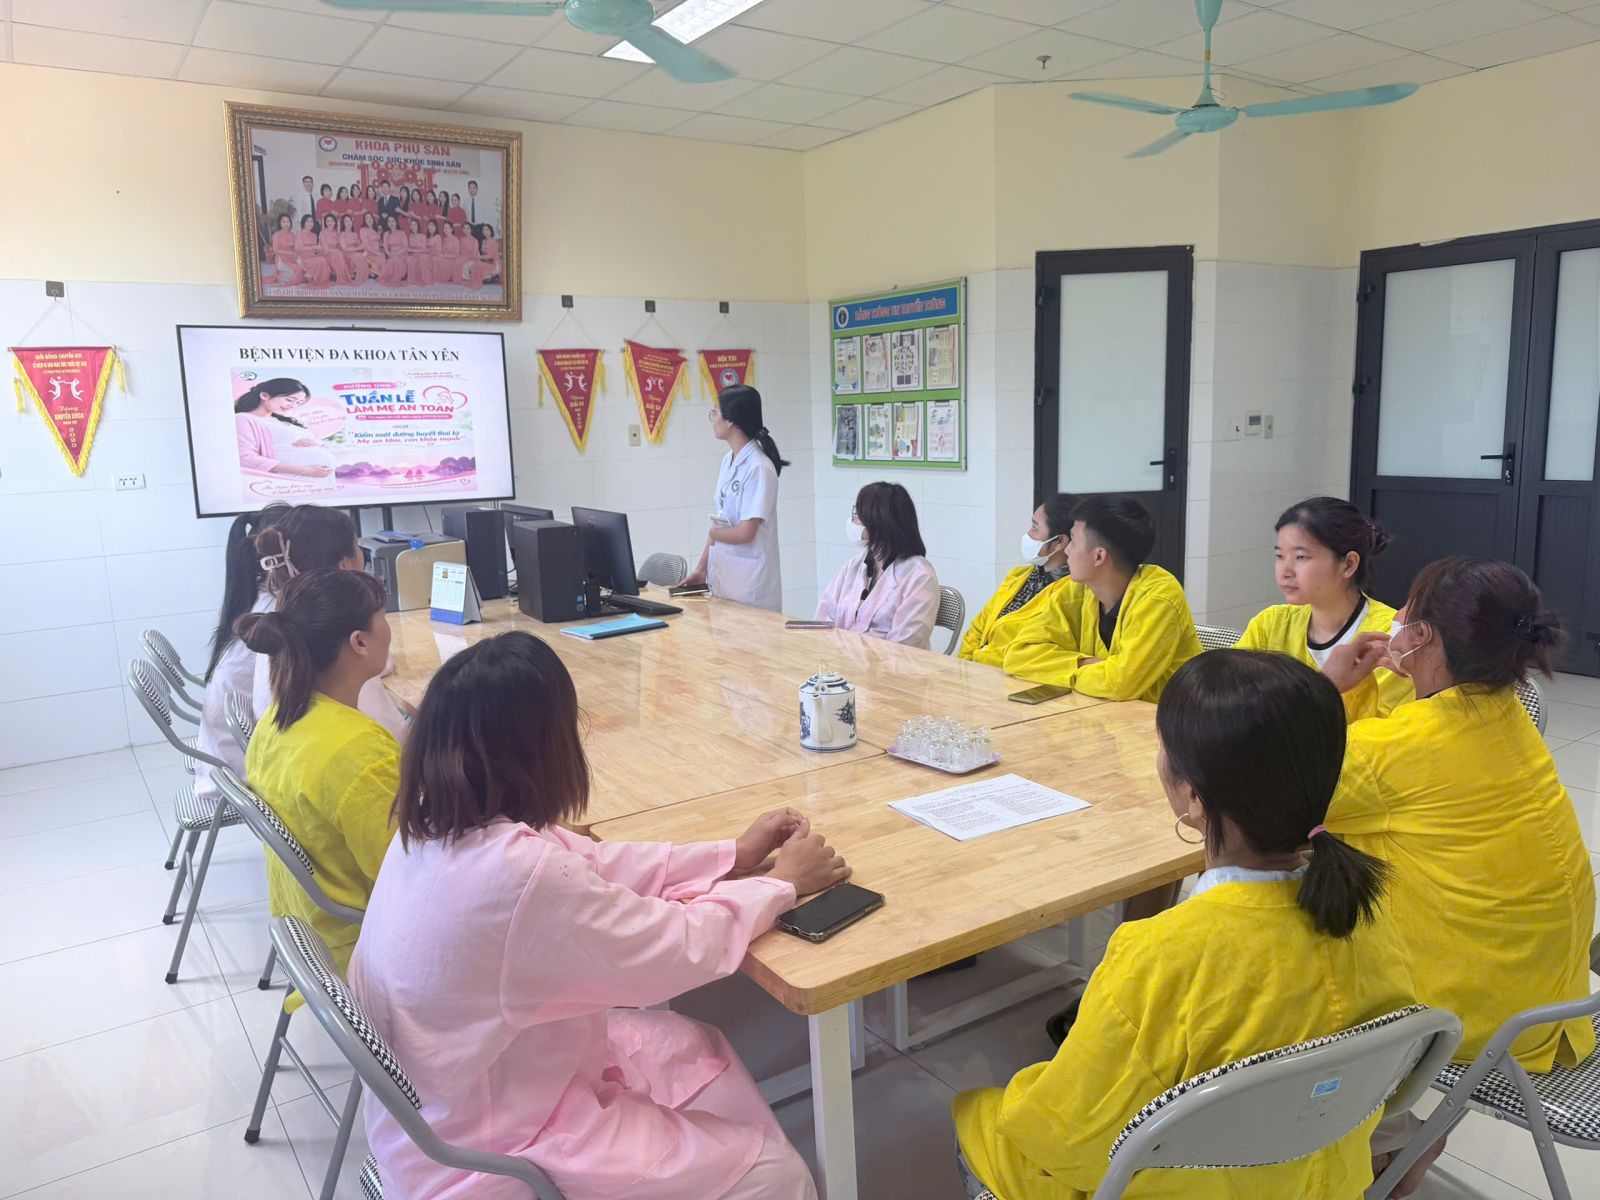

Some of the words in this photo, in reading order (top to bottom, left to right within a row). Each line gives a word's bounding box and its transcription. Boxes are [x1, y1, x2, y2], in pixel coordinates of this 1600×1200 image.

[355, 140, 390, 152] KHOA
[239, 346, 283, 362] BỆNH
[287, 346, 325, 363] VIỆN
[329, 348, 348, 360] ĐA
[353, 348, 396, 361] KHOA
[398, 346, 429, 361] TÂN
[432, 347, 460, 361] YÊN
[340, 390, 393, 405] TUẦN
[396, 389, 416, 403] LỄ
[377, 404, 396, 414] MẸ
[398, 404, 417, 412] AN
